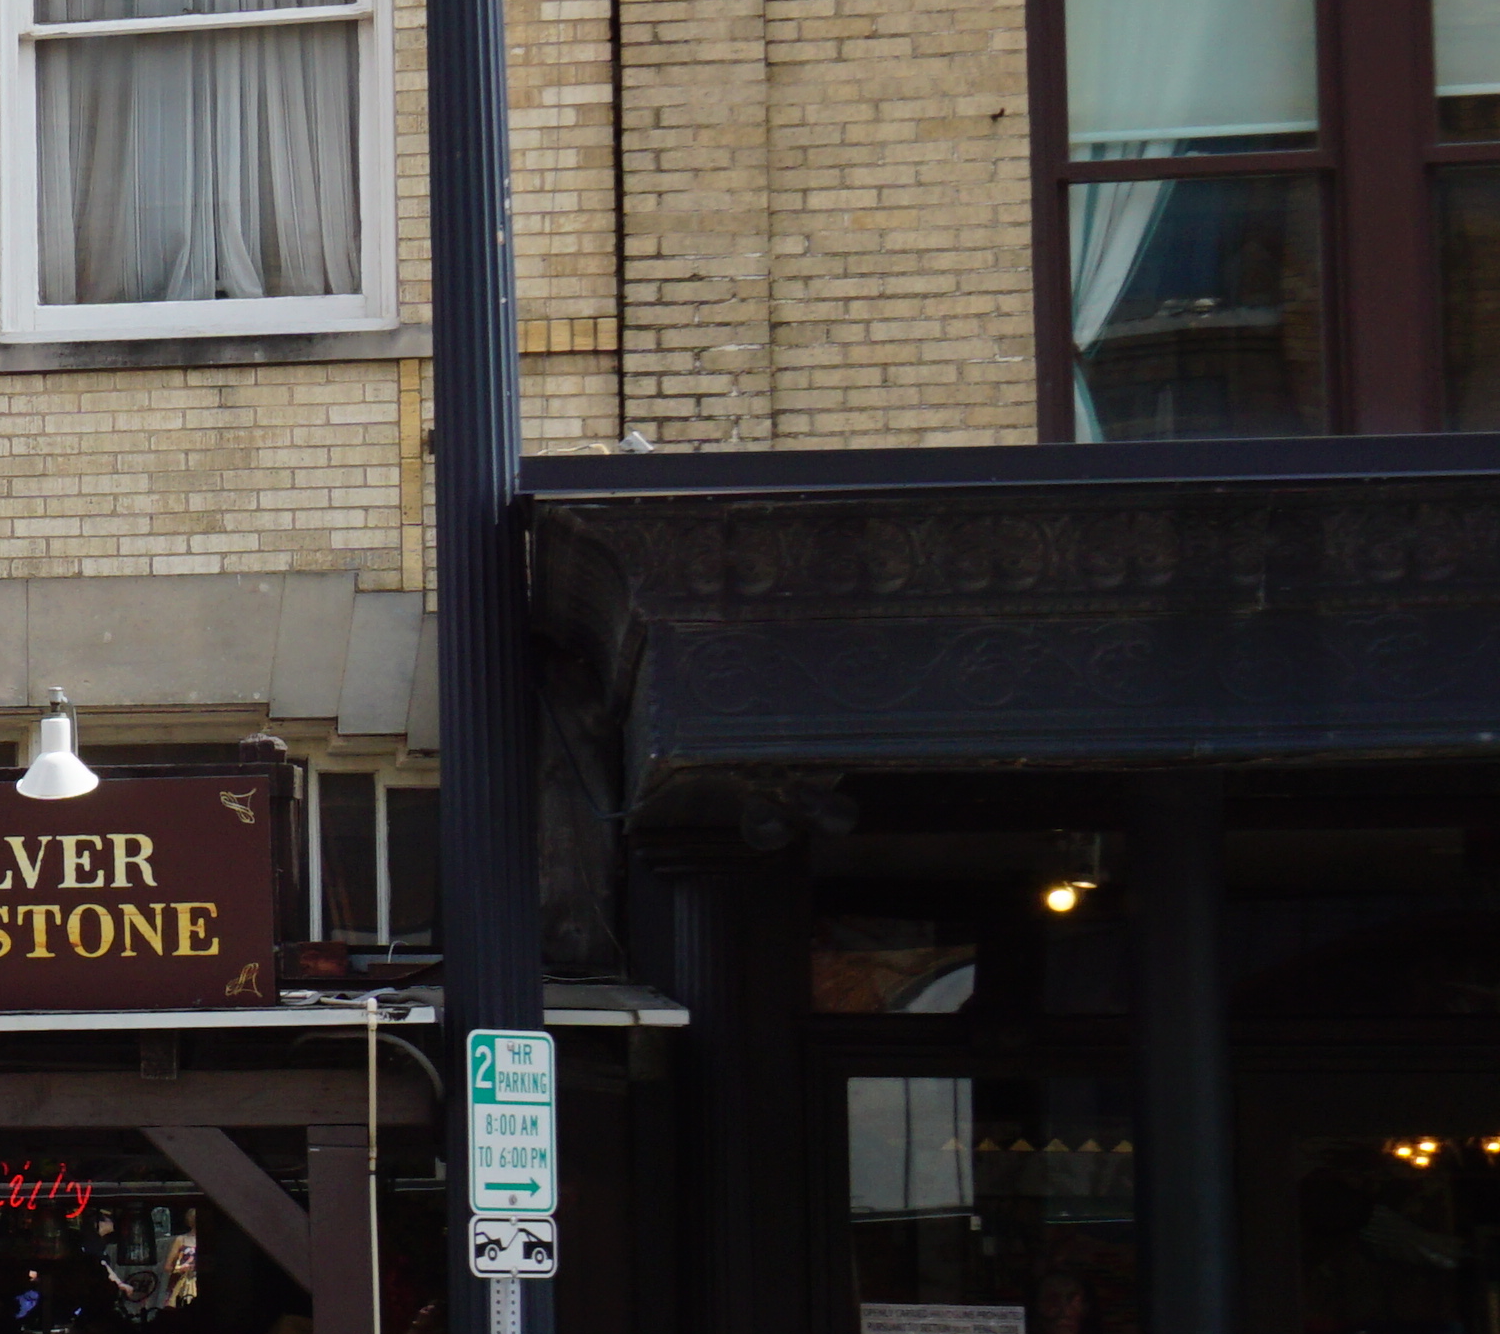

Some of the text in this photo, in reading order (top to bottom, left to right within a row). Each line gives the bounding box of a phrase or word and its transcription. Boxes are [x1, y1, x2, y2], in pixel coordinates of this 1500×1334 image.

[511, 1044, 533, 1065] HR
[474, 1045, 492, 1089] 2
[498, 1071, 547, 1094] PARKING
[486, 1113, 539, 1136] 8:00 AM
[478, 1146, 547, 1169] TO 6:00 PM
